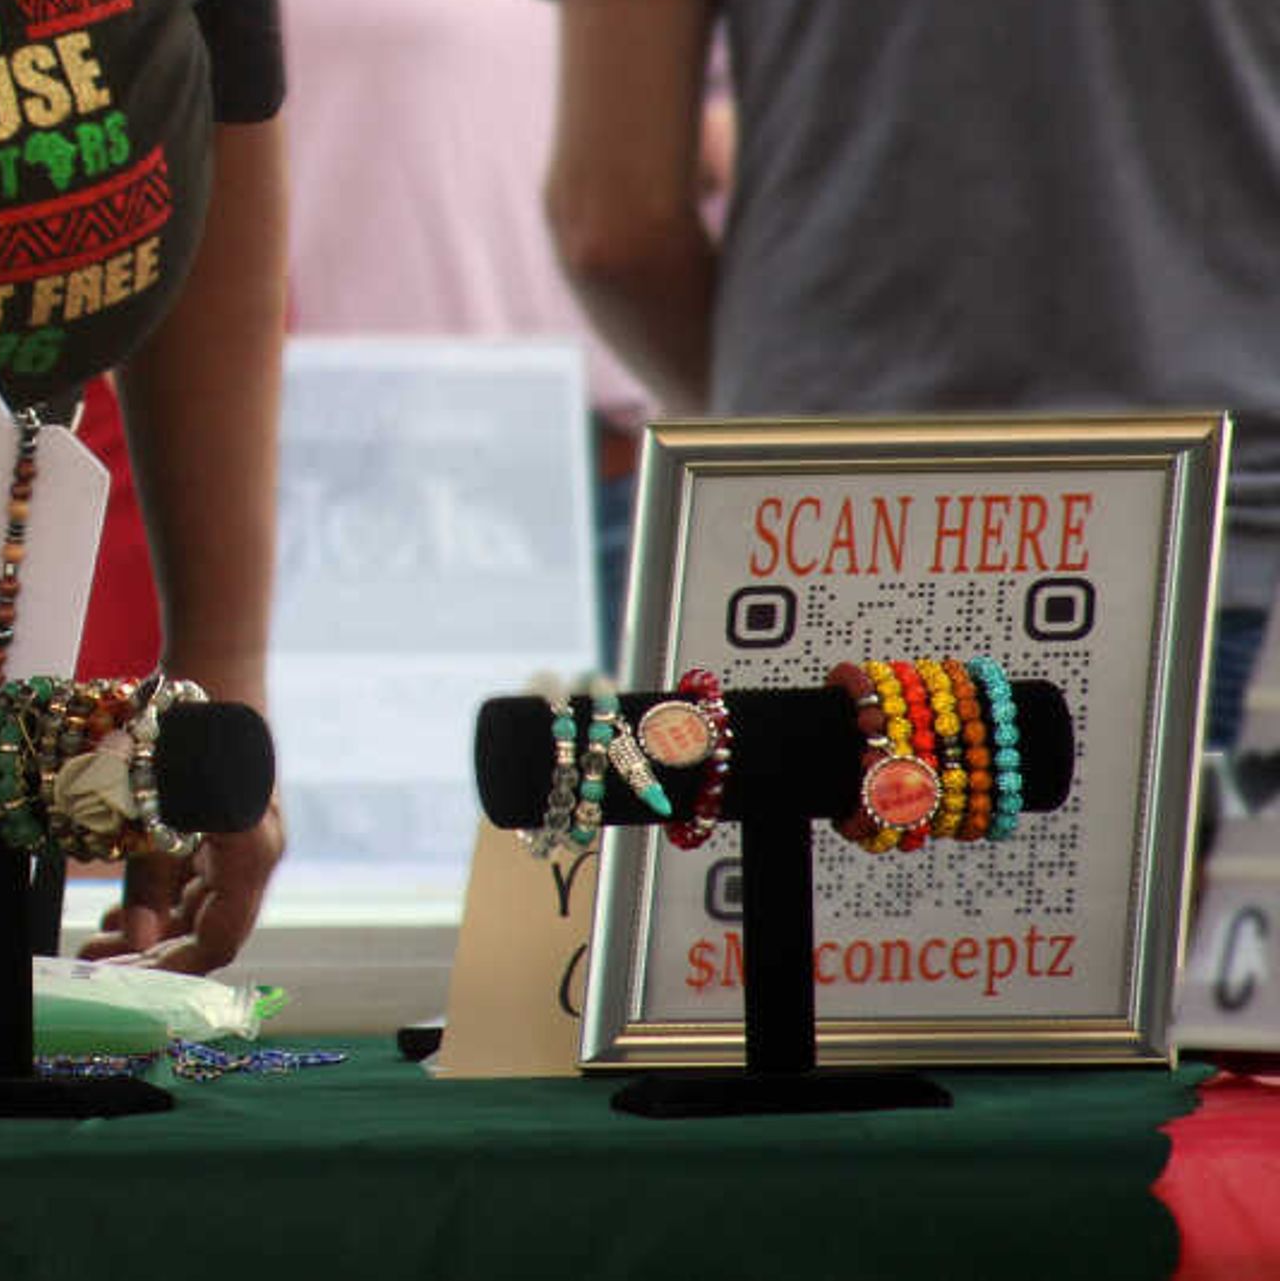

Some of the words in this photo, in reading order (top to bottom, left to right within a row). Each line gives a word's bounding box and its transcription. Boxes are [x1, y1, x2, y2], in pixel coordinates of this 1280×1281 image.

[31, 236, 163, 327] FREE
[748, 494, 913, 577] SCAN
[929, 492, 1094, 574] HERE
[685, 924, 1076, 996] $Mconceptz
